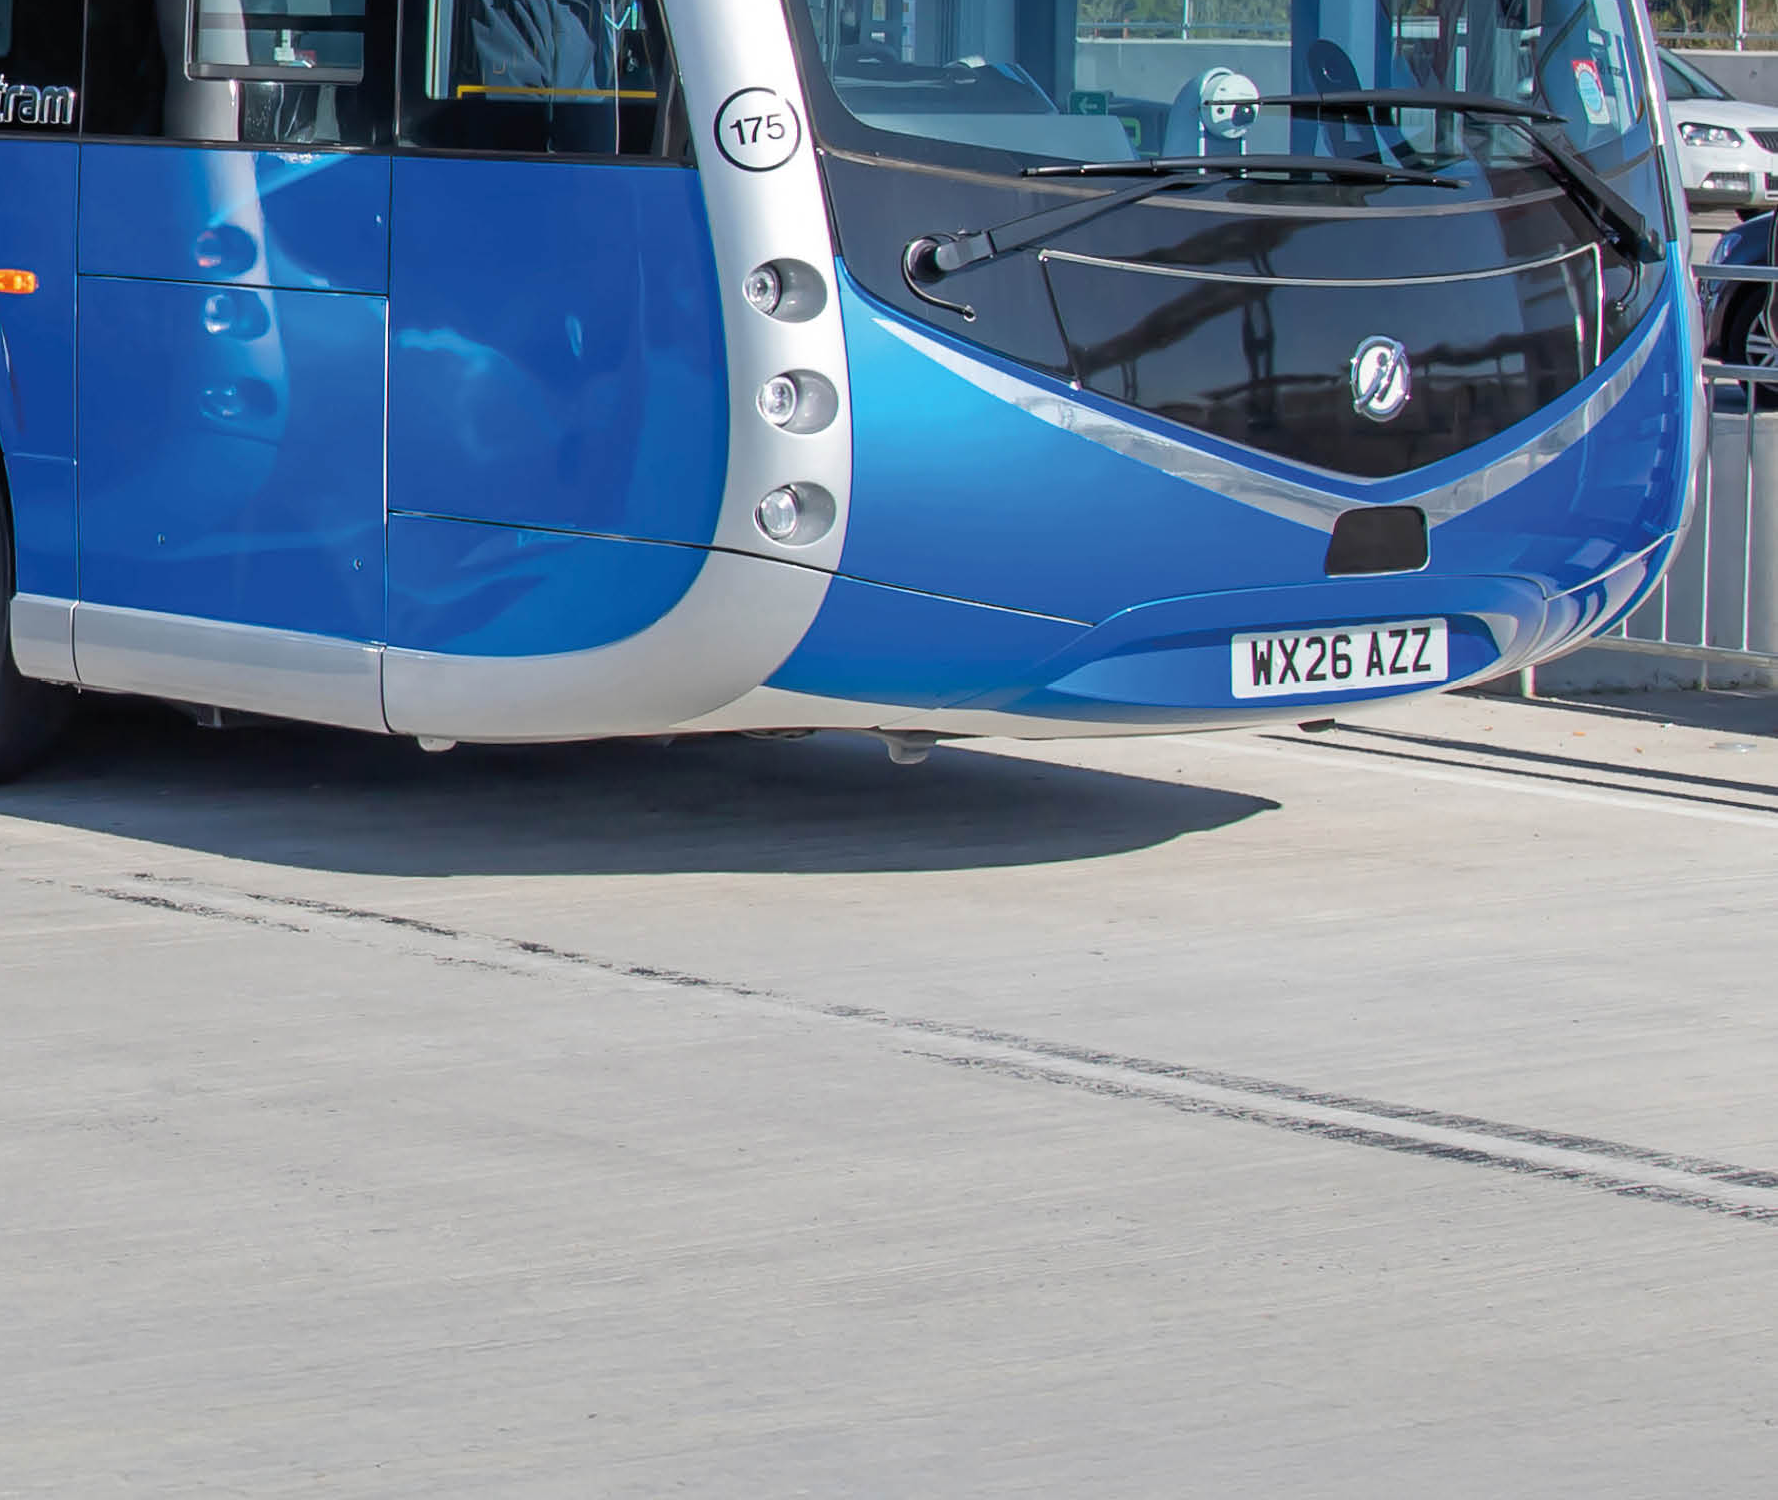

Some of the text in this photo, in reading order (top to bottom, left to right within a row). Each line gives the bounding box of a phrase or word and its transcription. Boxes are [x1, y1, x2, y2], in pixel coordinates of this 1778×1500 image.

[729, 112, 786, 145] 175
[1250, 626, 1432, 686] WX26 AZZ
